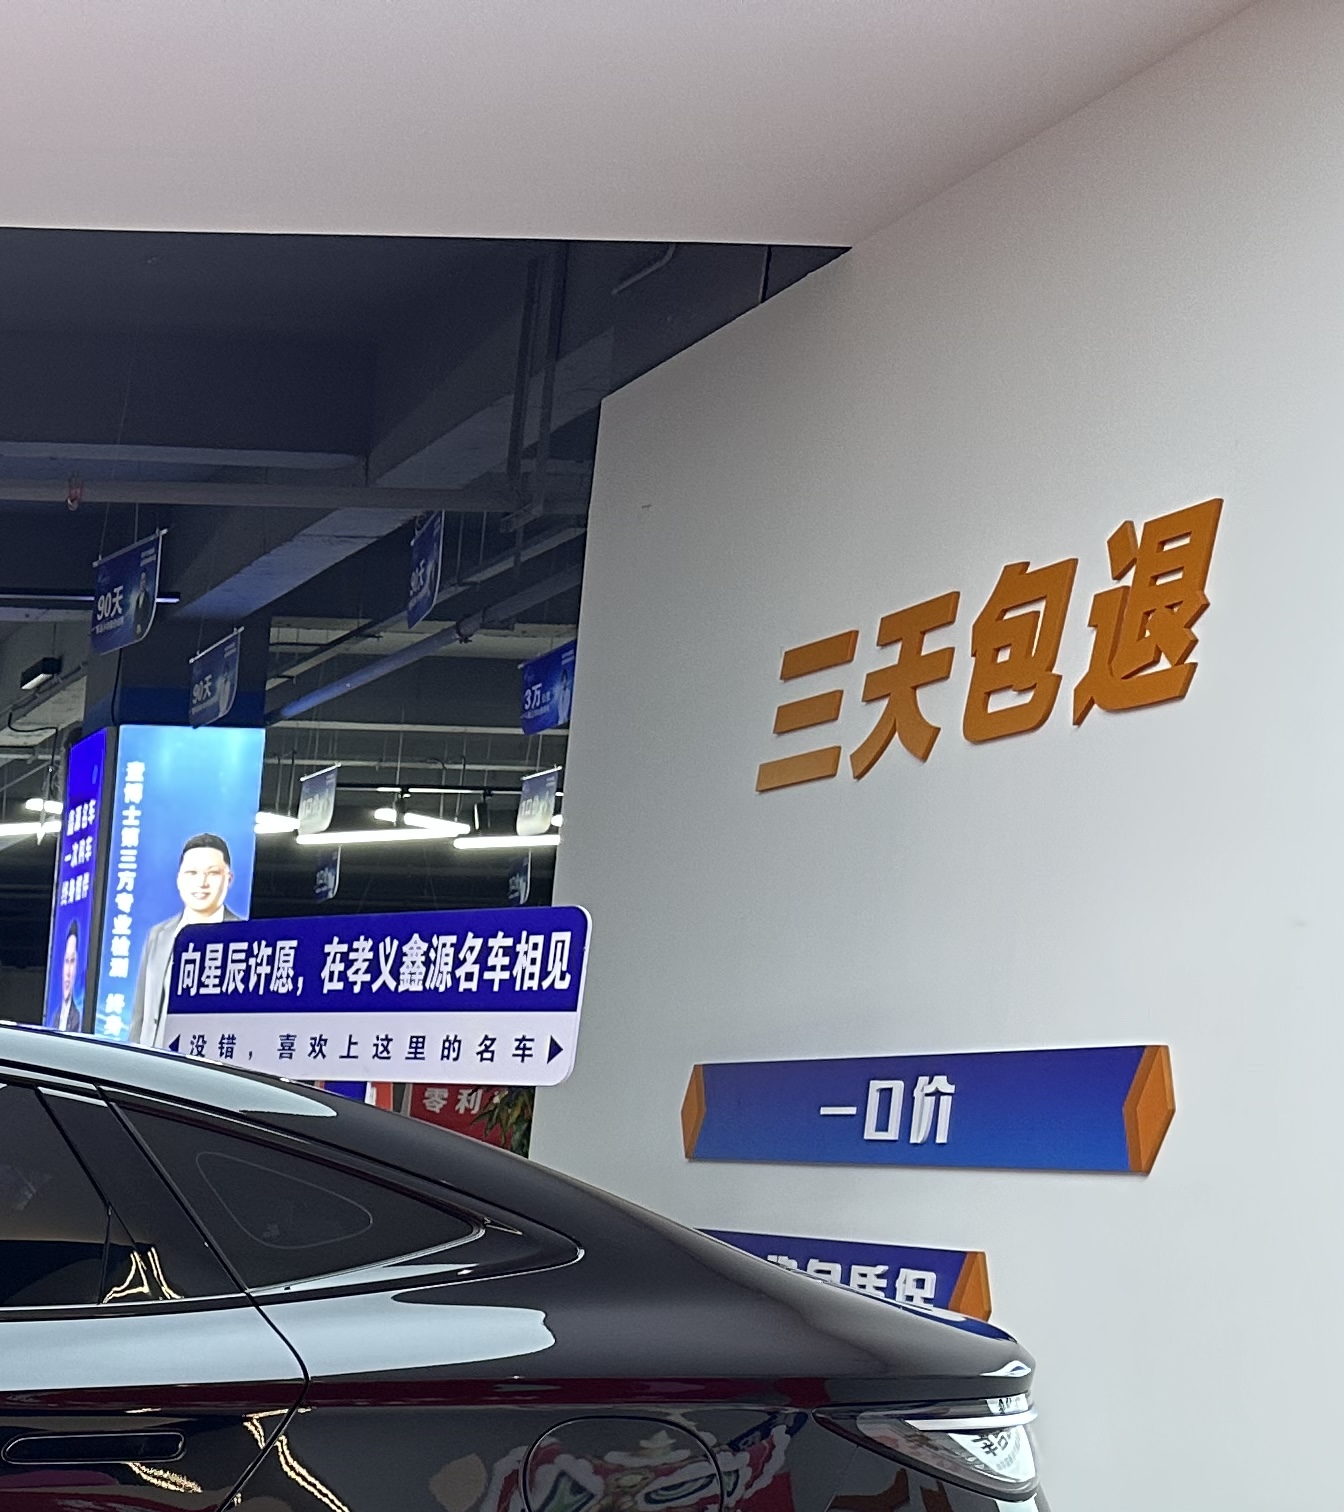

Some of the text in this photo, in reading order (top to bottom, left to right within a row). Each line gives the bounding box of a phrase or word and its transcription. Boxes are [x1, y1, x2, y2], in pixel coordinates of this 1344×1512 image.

[97, 585, 124, 621] 90天
[756, 497, 1224, 793] 三天包退
[422, 1087, 508, 1115] 零利
[819, 1074, 956, 1144] 一口价
